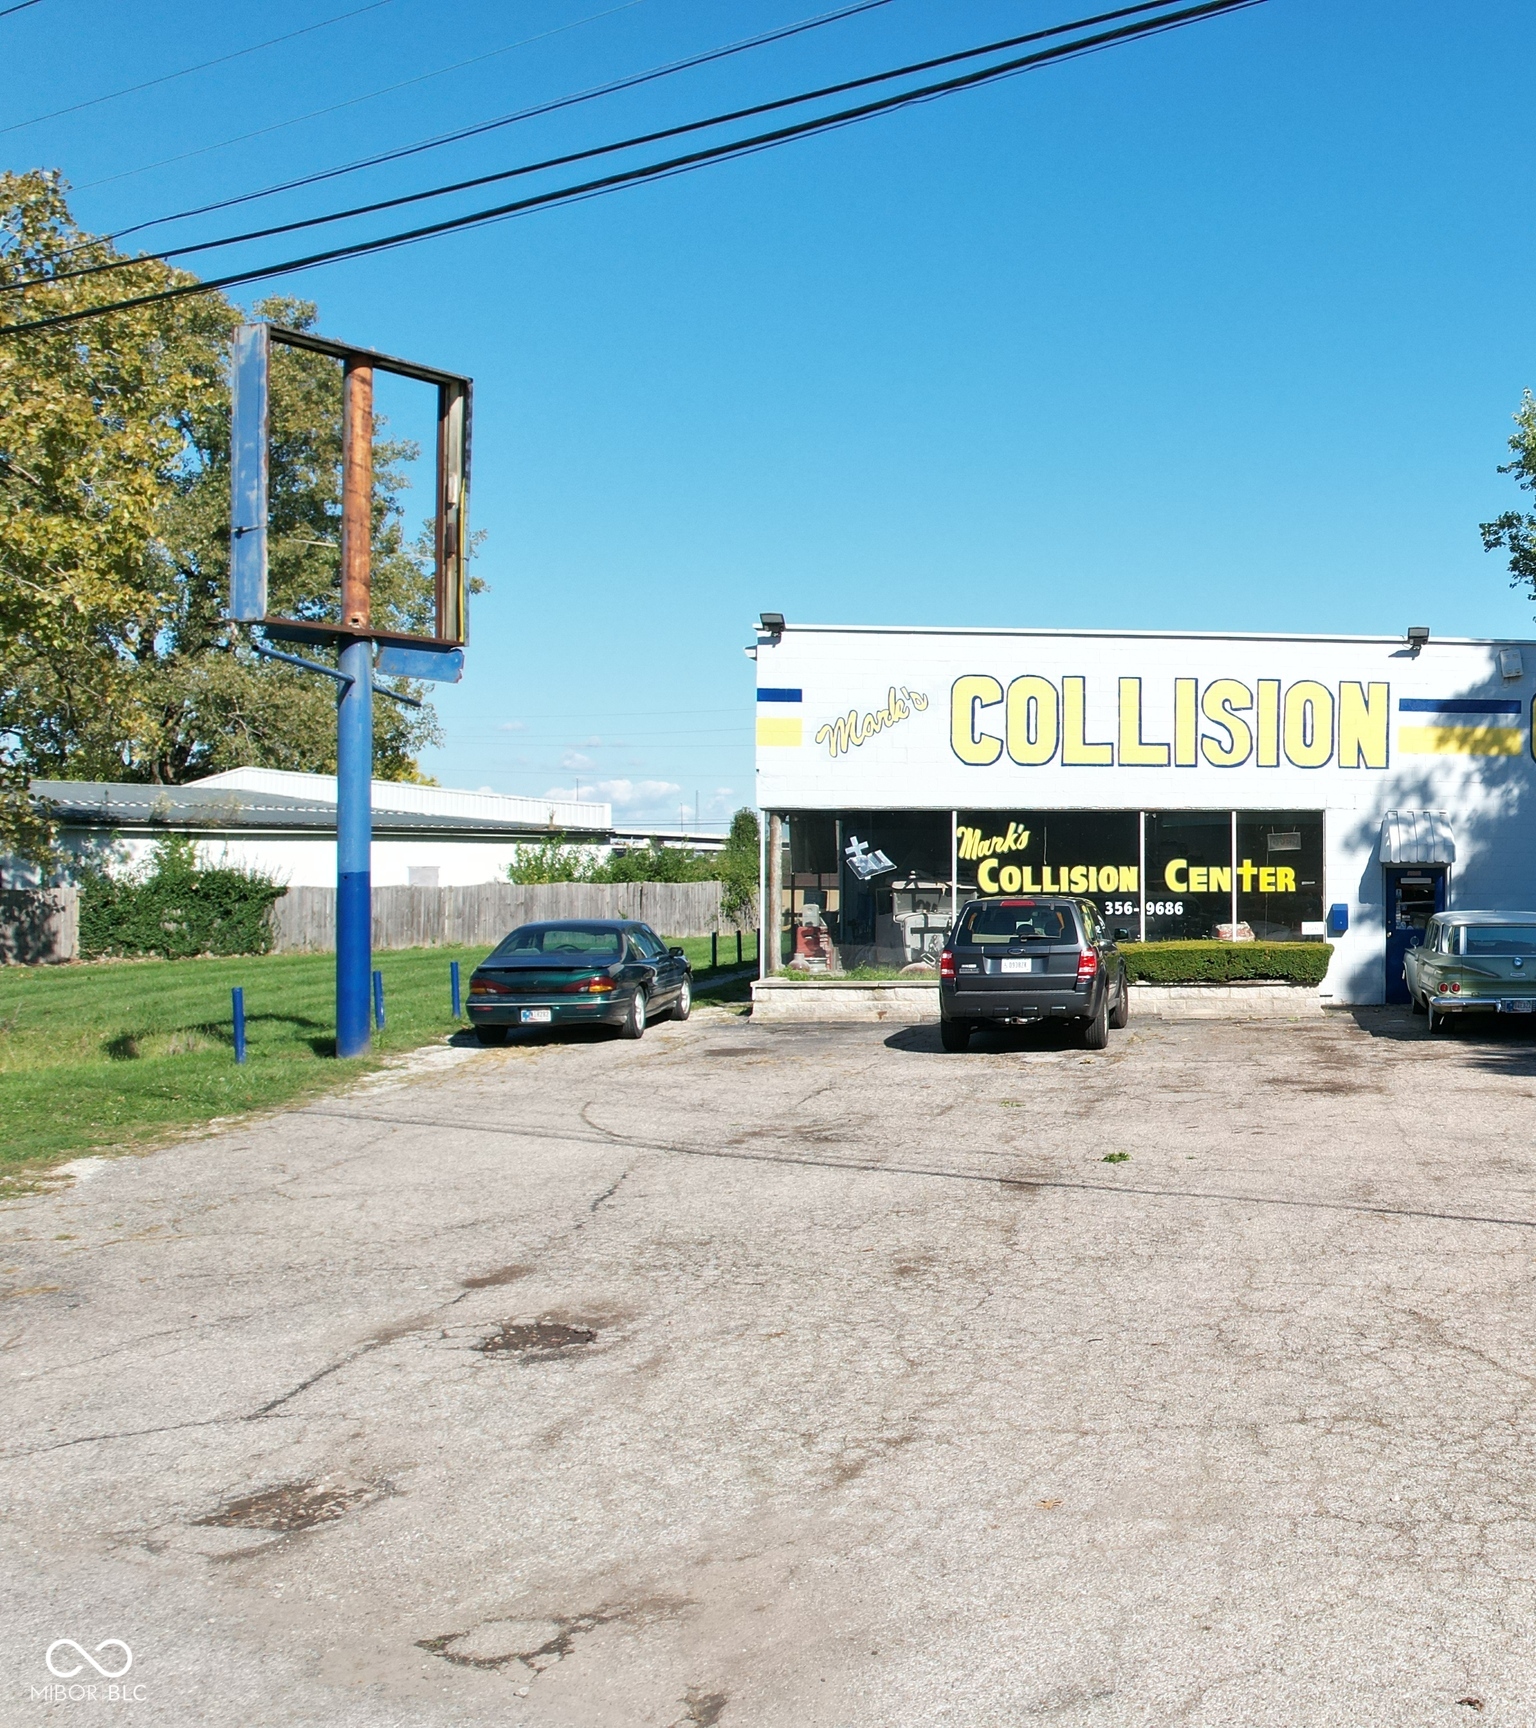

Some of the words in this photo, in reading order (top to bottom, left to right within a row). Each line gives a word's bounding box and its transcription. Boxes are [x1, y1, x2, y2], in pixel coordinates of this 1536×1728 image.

[815, 686, 929, 758] Mark's
[950, 674, 1390, 769] COLLISION
[956, 822, 1030, 861] Mark's
[1104, 901, 1184, 916] 356-9686
